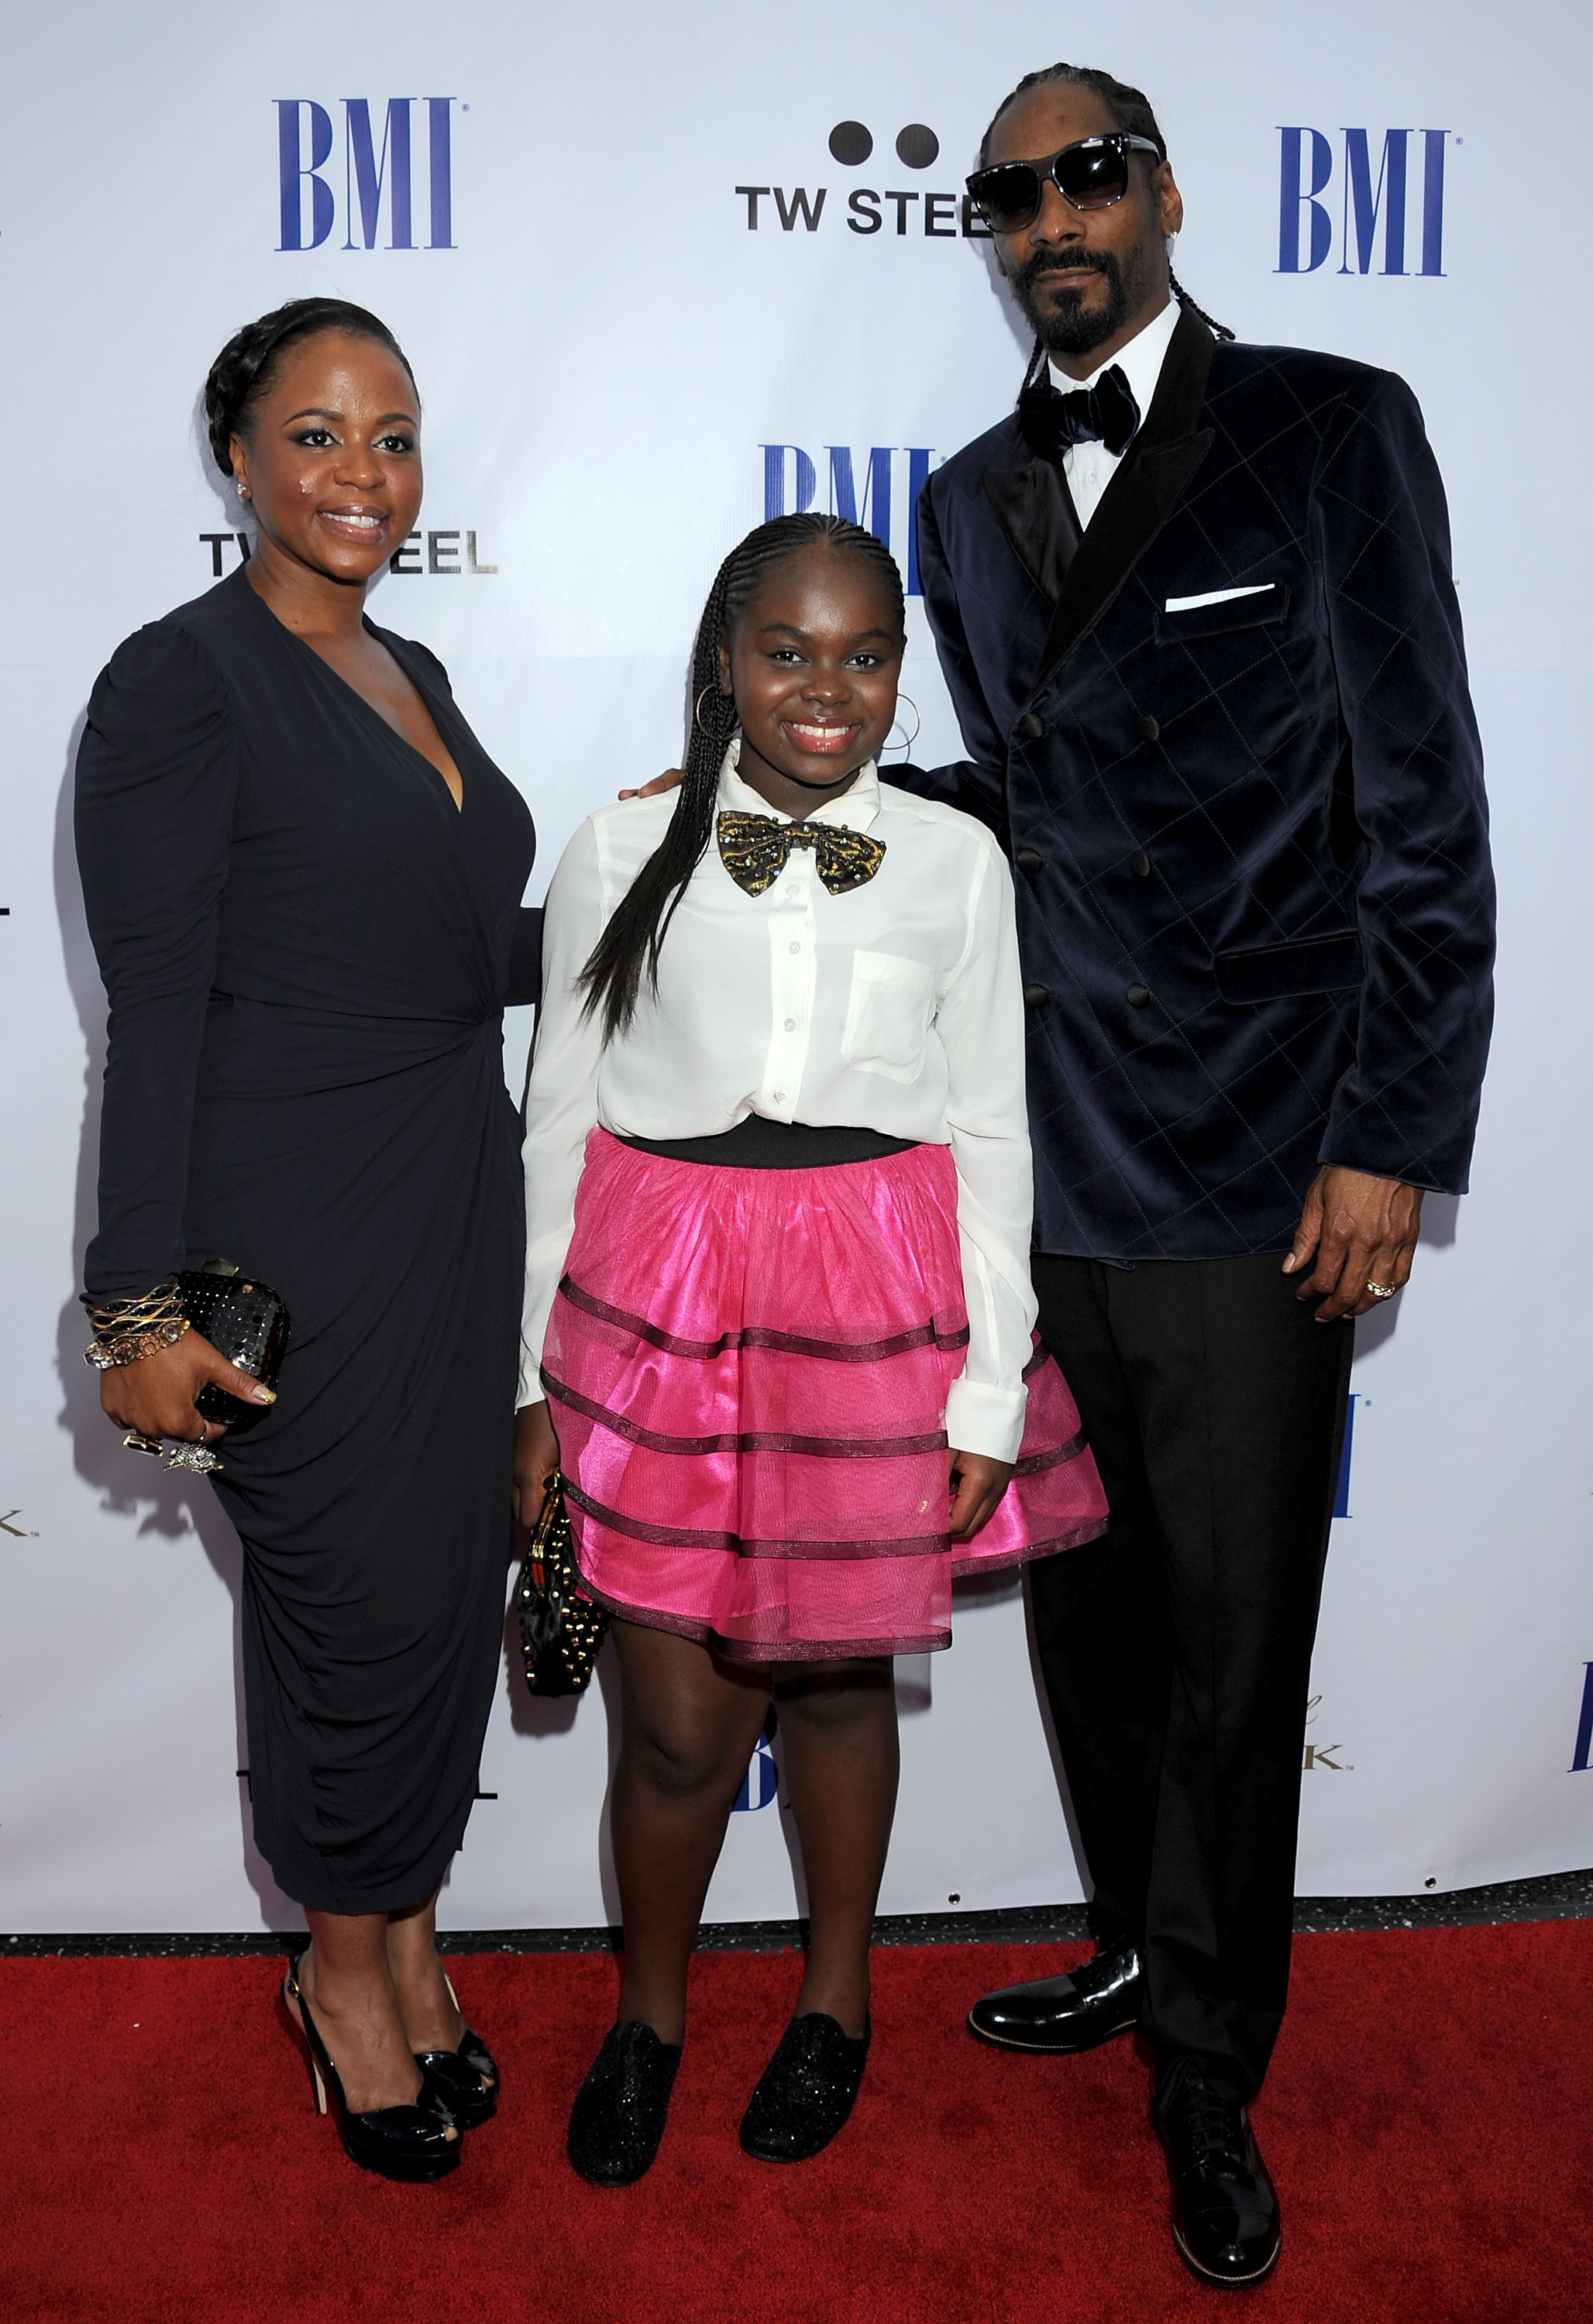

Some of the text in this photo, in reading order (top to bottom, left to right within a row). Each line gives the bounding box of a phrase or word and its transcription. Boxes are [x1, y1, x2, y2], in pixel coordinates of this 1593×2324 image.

[271, 97, 458, 252] BMI
[735, 186, 993, 238] TW STEE
[1272, 126, 1452, 277] BMI
[199, 531, 498, 576] T EEL
